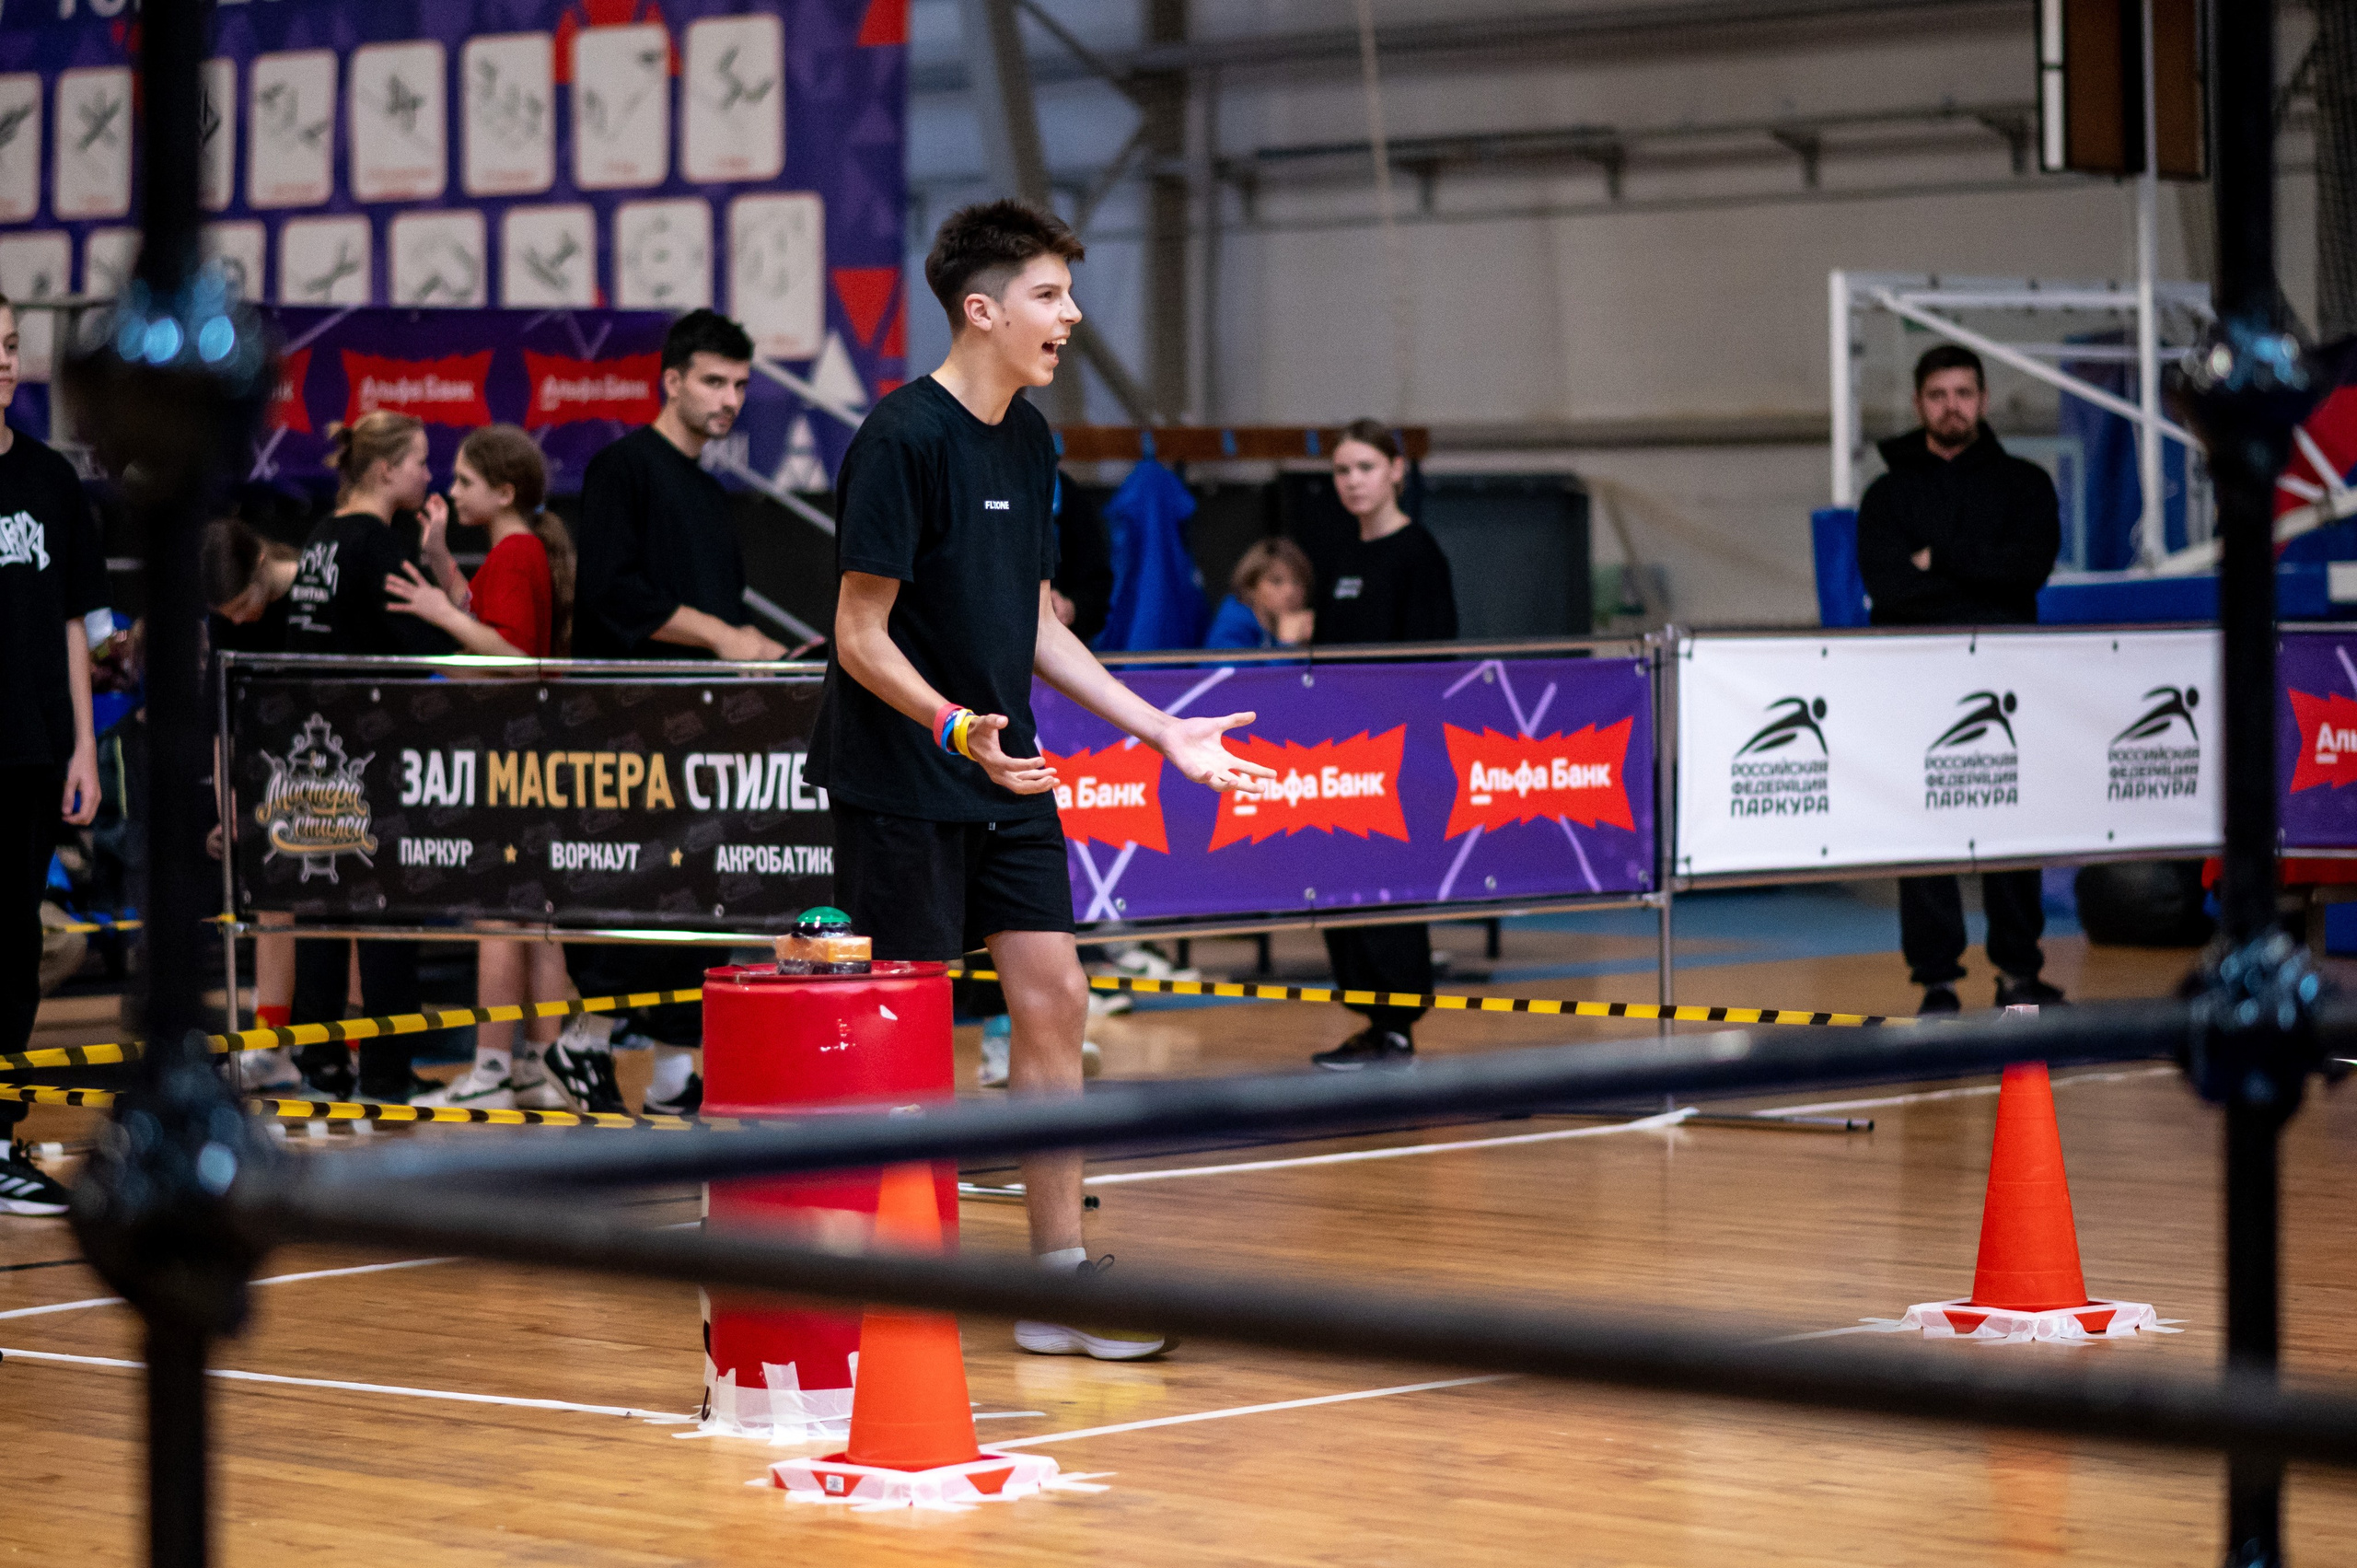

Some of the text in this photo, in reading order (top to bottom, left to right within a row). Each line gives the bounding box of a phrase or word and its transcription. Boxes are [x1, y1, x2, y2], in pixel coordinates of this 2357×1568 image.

[401, 749, 830, 810] ЗАЛ МАСТЕРА СТИЛЕ
[1321, 766, 1385, 797] Банк
[1470, 757, 1610, 805] Альфа Банк
[1732, 758, 1828, 776] РОССИЙСКАЯ
[1077, 776, 1145, 808] Банк
[1732, 777, 1827, 795] ФЕДЕРАЦИЯ
[1925, 788, 2017, 809] ПАРКУРА
[2108, 779, 2197, 801] ПАРКУРА
[1732, 796, 1829, 817] ПАРКУРА
[400, 836, 473, 866] ПАРКУР
[551, 841, 641, 872] ВОРКАУТ
[715, 844, 834, 874] АКРОБАТИК
